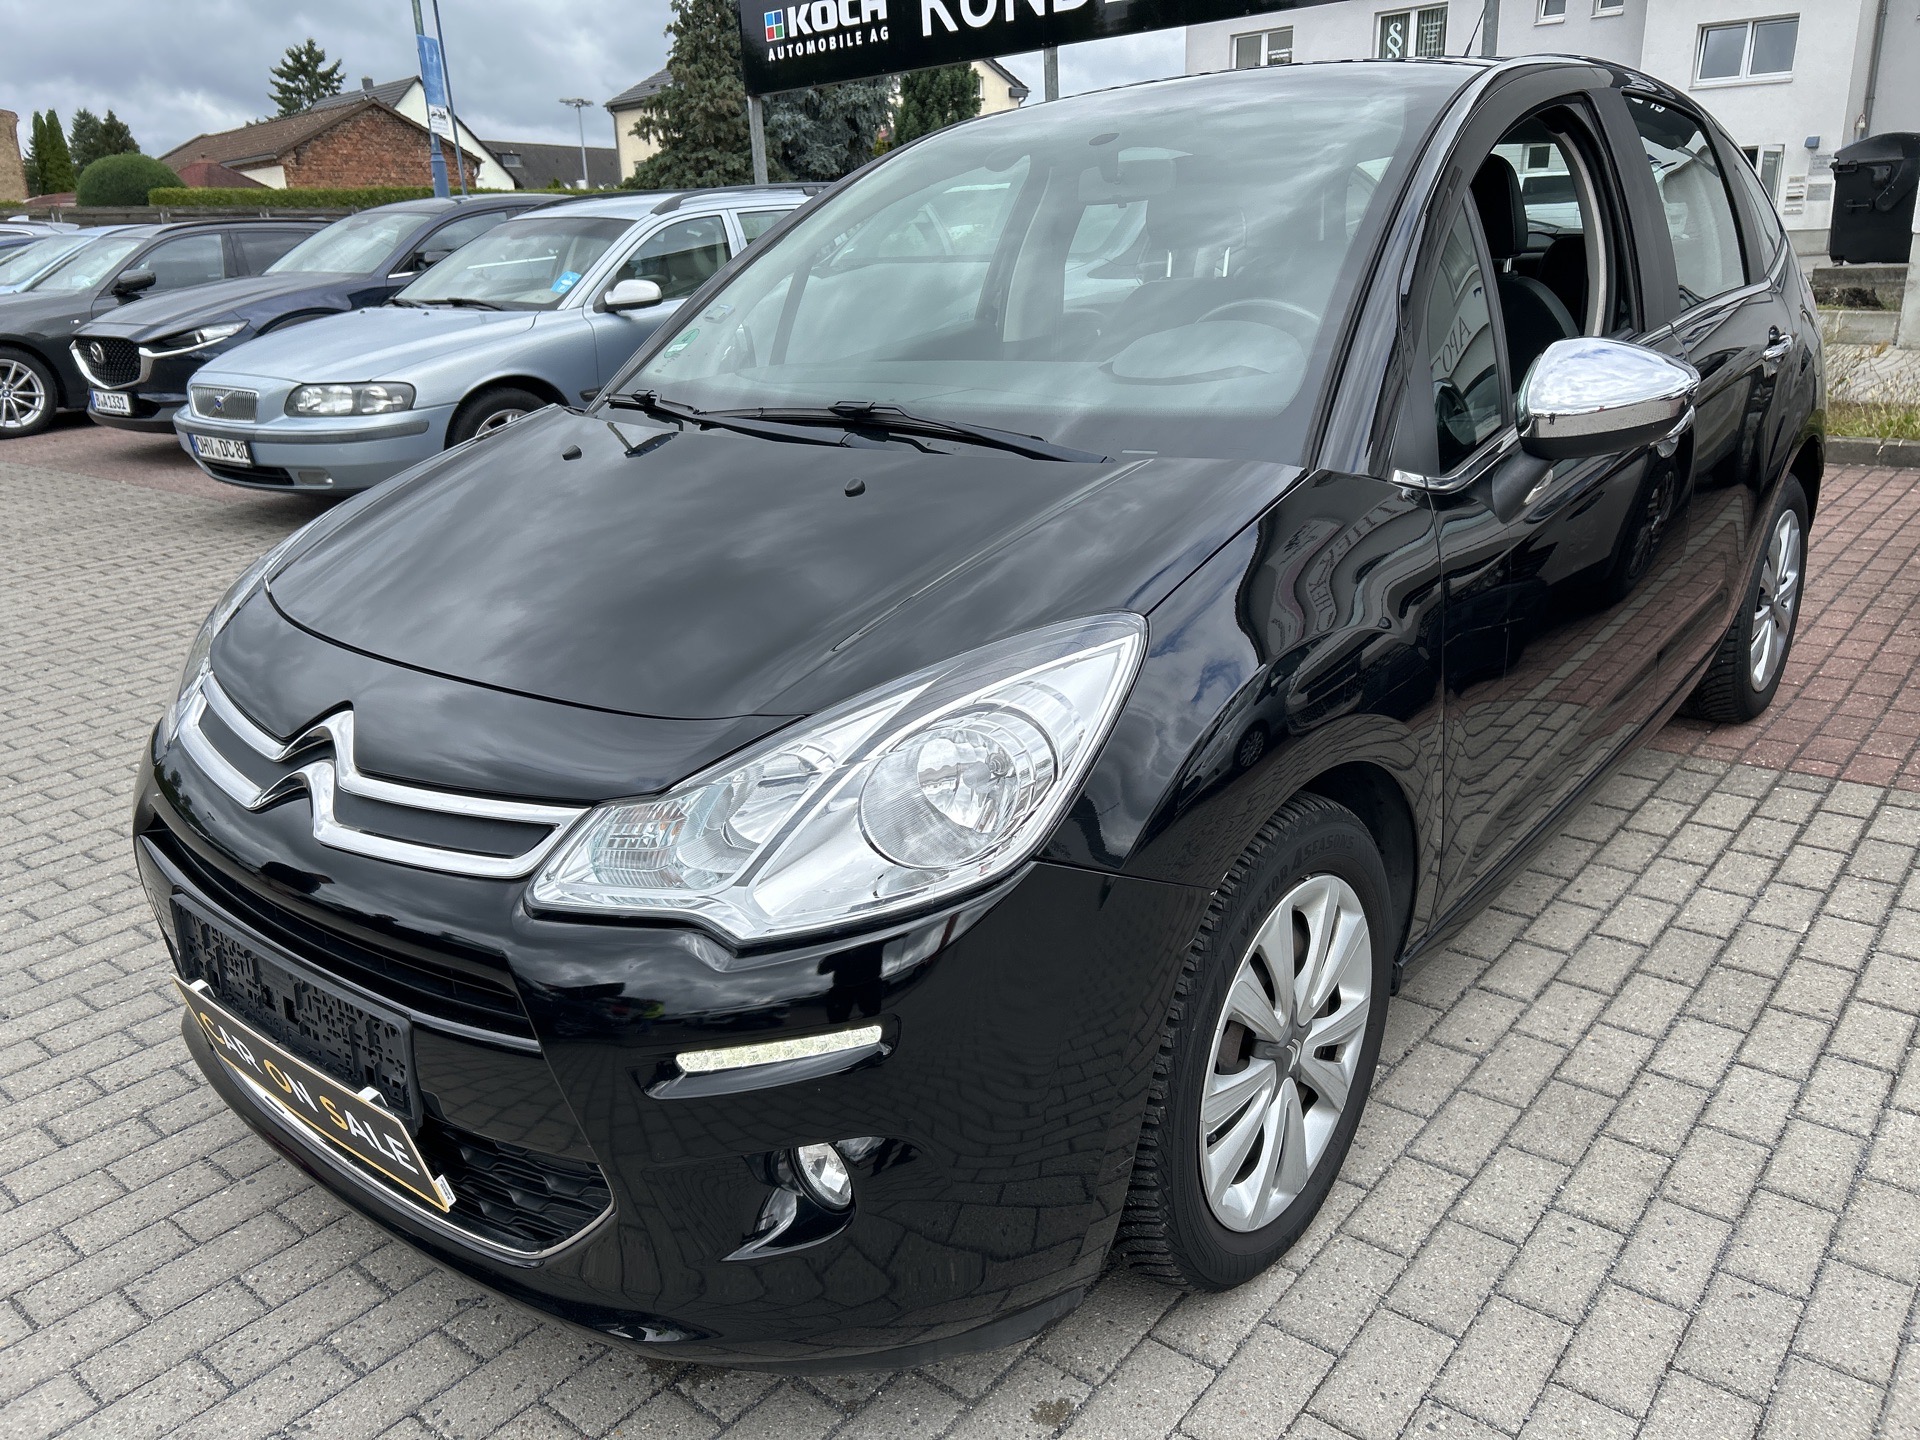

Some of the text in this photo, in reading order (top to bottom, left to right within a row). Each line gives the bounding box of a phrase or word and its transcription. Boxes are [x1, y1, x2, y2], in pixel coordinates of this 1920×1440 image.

[787, 0, 888, 38] KOCH
[767, 26, 889, 62] AUTOMOBILE AG
[199, 1012, 420, 1176] CAR ON SALE
